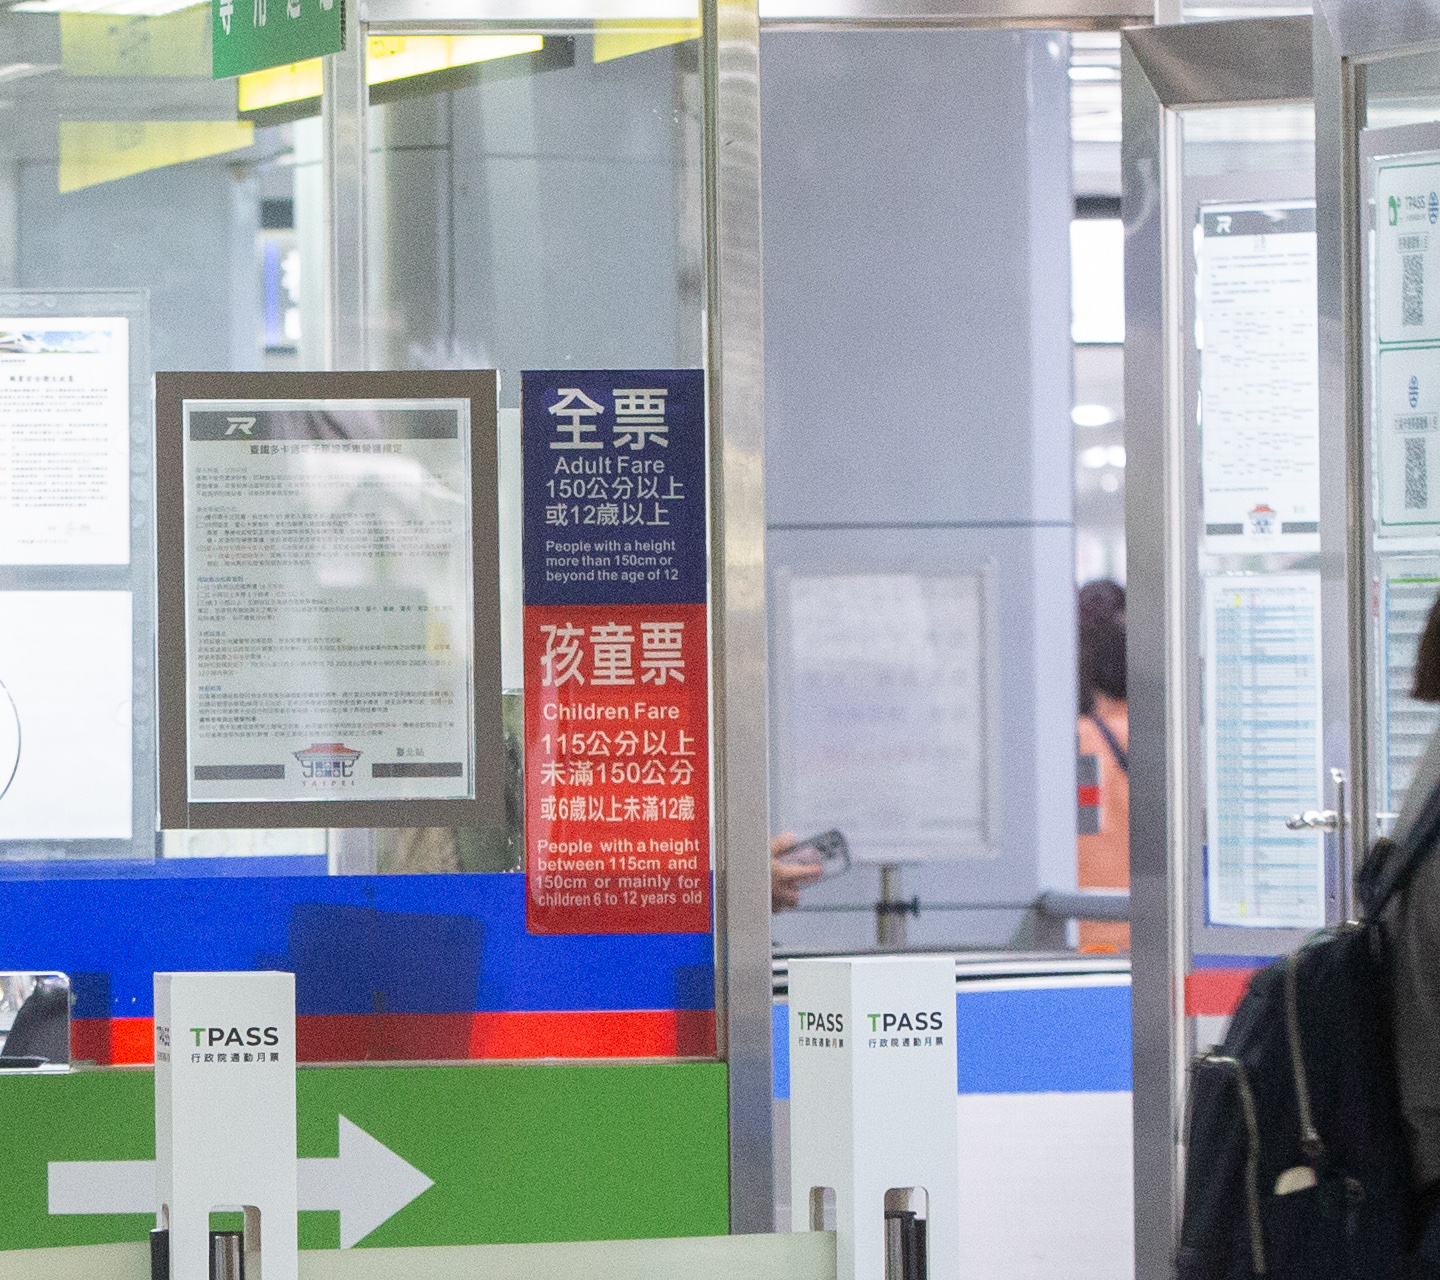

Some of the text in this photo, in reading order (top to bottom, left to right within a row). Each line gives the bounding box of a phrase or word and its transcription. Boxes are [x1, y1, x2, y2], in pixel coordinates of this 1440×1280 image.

[548, 388, 669, 450] 全票
[554, 456, 665, 474] Adult Fare
[545, 476, 685, 500] 150公分以上
[545, 502, 670, 526] 或12歲以上
[546, 540, 676, 554] People with a height
[546, 555, 672, 567] more than 150cm or
[546, 569, 679, 583] beyond the age of 12
[540, 622, 686, 687] 孩童票
[543, 702, 680, 721] Children Fare
[541, 730, 696, 757] 115公分以上
[540, 759, 694, 787] 未滿150公分
[540, 795, 696, 822] 或6歲以上未滿12歲
[537, 839, 700, 856] People with a height
[538, 856, 698, 871] between 115cm and
[536, 874, 700, 891] 150cm or mainly for
[538, 890, 703, 908] children 6 to 12 years old
[798, 1011, 844, 1033] TPASS
[867, 1011, 943, 1032] TPASS
[190, 1026, 279, 1047] TPASS
[868, 1036, 944, 1048] 行政院通勤月票
[191, 1052, 279, 1063] 行政院通勤月票
